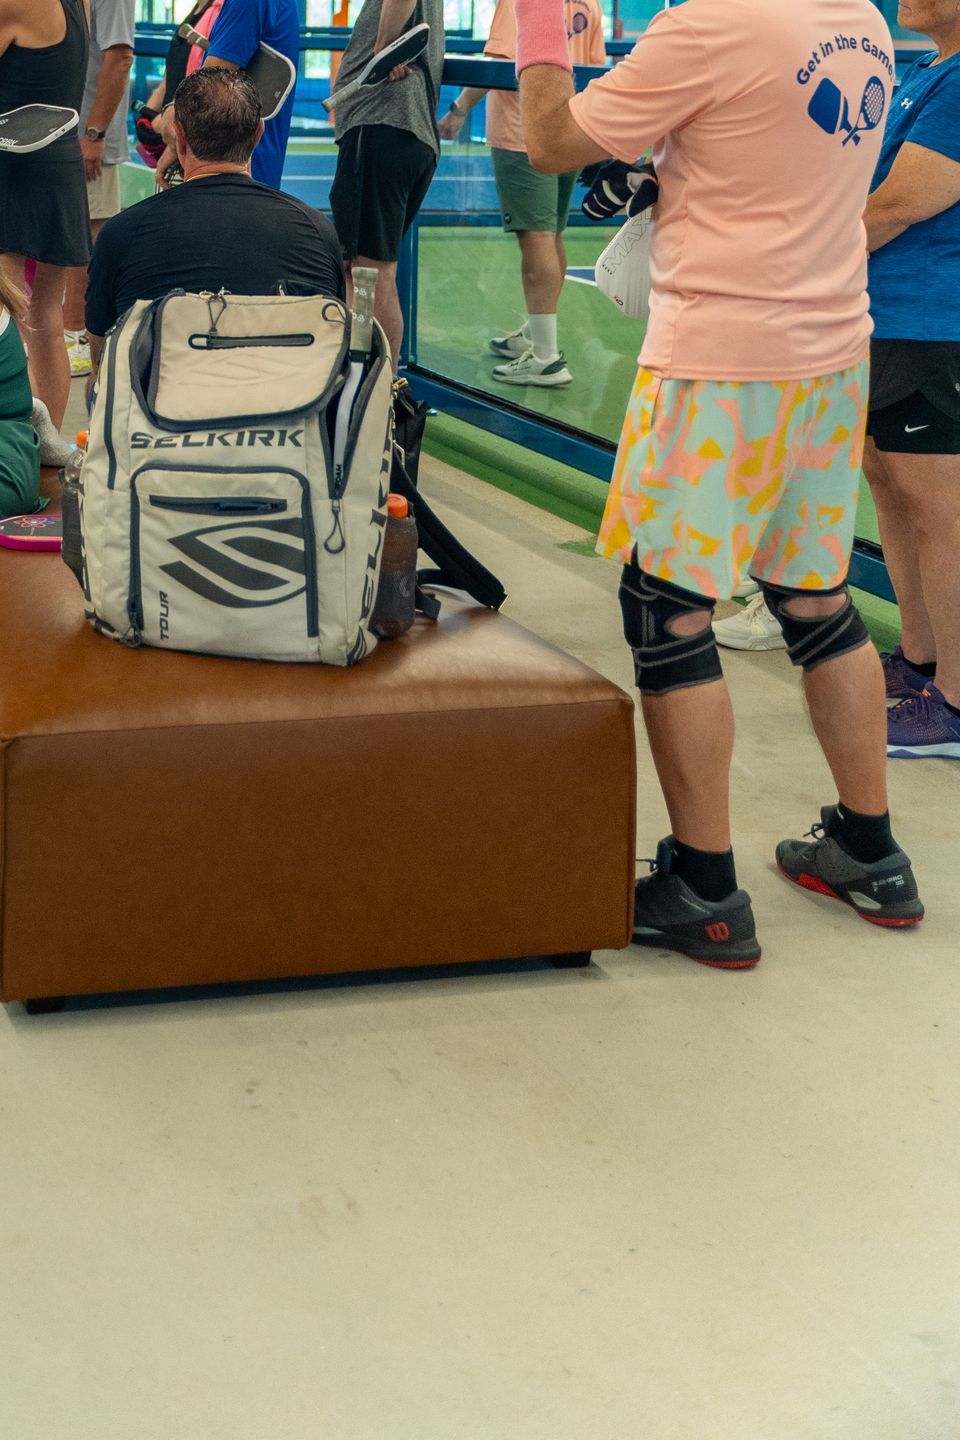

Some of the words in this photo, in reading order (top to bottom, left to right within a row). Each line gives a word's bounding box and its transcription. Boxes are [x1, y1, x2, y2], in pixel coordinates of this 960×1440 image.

[796, 51, 821, 85] Get
[819, 41, 834, 58] in
[834, 33, 857, 50] the
[130, 428, 305, 449] SELKIRK
[158, 590, 170, 641] TOUR
